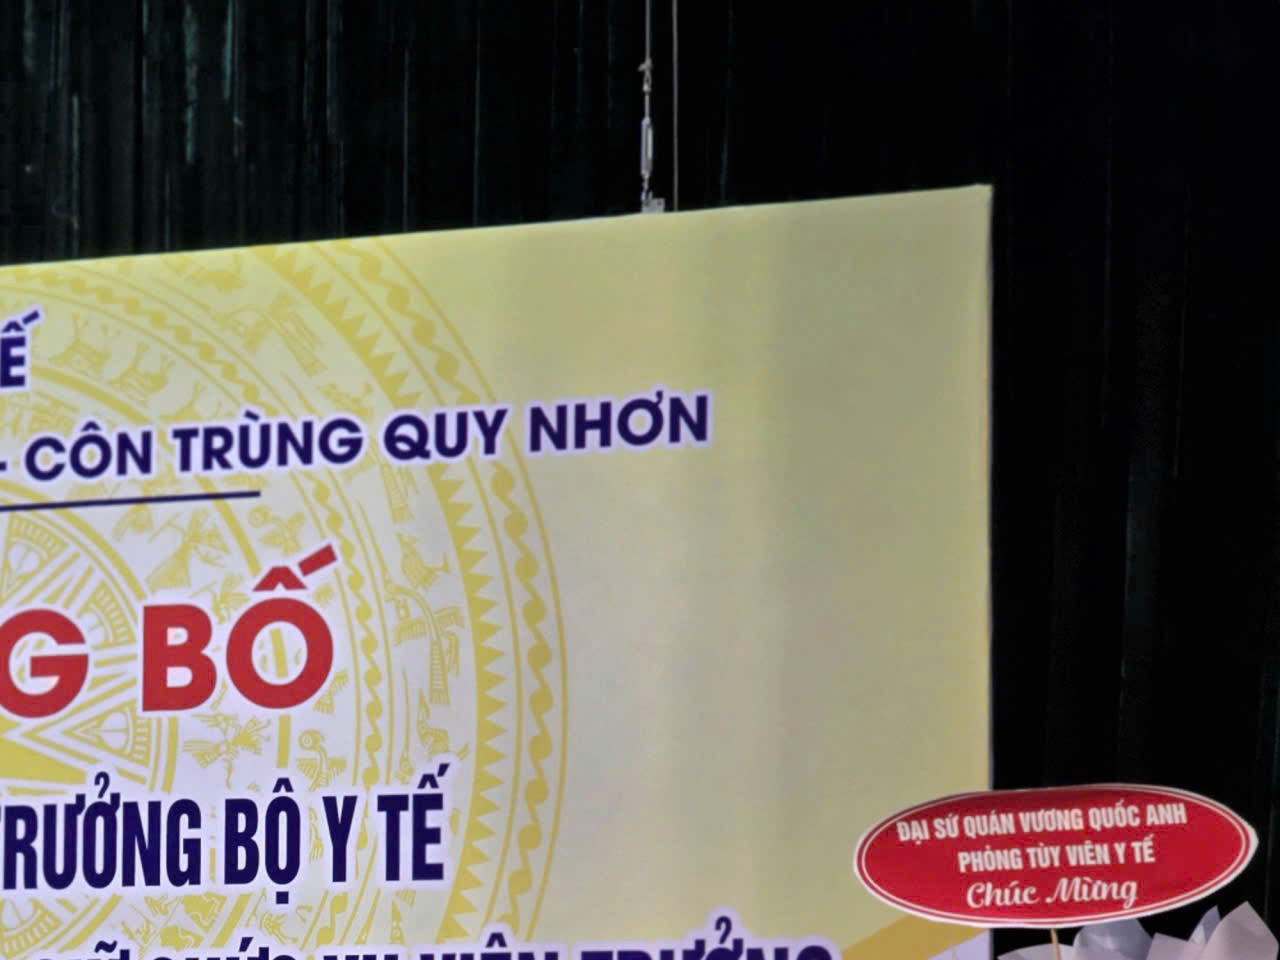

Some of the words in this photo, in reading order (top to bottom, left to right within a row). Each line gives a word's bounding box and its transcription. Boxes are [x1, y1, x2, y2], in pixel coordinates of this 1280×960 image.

[26, 422, 151, 480] CÔN
[173, 411, 362, 471] TRÙNG
[384, 409, 507, 460] QUY
[530, 391, 707, 452] NHƠN
[144, 547, 334, 710] BỐ
[225, 778, 300, 904] BỘ
[323, 796, 357, 882] Y
[378, 763, 449, 881] TẾ
[897, 820, 930, 844] ĐẠI
[934, 816, 958, 838] SỨ
[964, 811, 1015, 838] QUÁN
[1019, 809, 1083, 832] VƯƠNG
[1089, 800, 1140, 831] QUỐC
[1147, 803, 1186, 825] ANH
[958, 846, 1023, 872] PHÒNG
[1026, 843, 1060, 868] TÙY
[1066, 840, 1110, 866] VIÊN
[1114, 843, 1125, 863] Y
[1131, 835, 1155, 862] TẾ
[967, 881, 1035, 908] Chúc
[1045, 876, 1138, 909] Mừng
